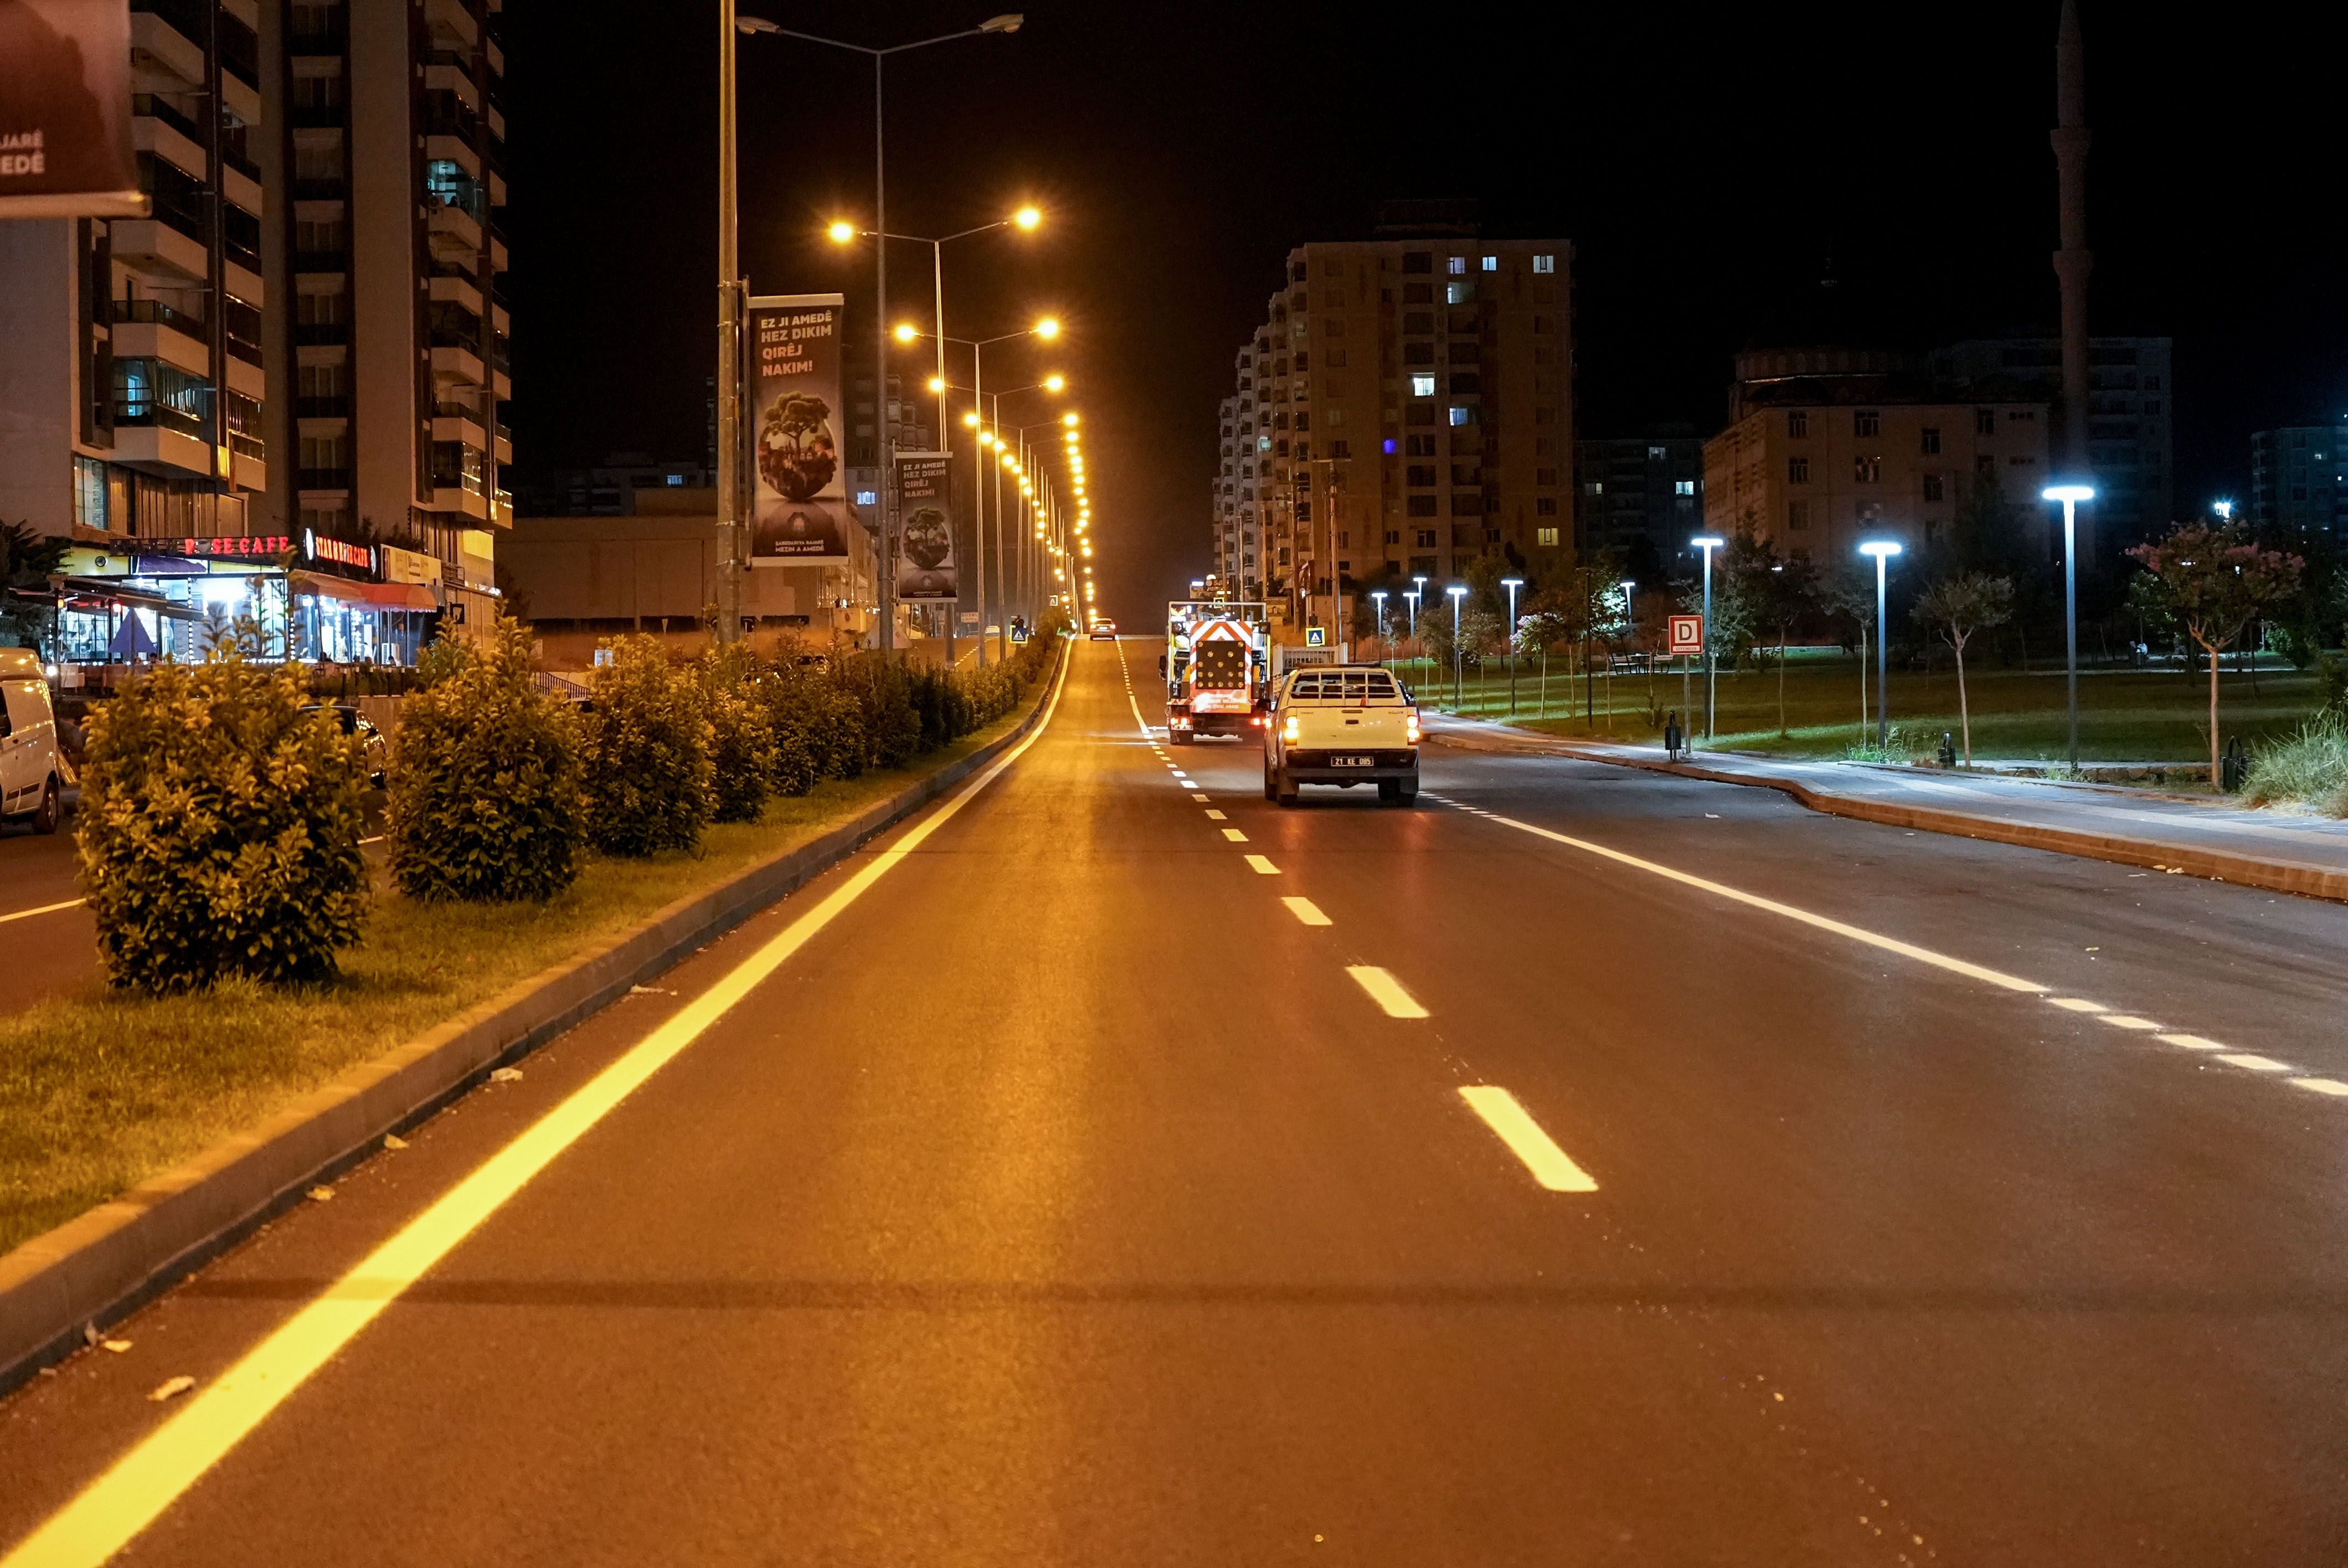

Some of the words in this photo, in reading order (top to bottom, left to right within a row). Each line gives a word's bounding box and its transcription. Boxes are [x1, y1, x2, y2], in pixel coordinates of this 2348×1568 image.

[761, 318, 775, 329] EZ
[779, 317, 789, 327] JI
[792, 310, 832, 326] AMEDÊ
[761, 329, 788, 343] HEZ
[792, 324, 832, 339] DIKIM
[763, 343, 802, 360] QIRÊJ
[763, 360, 812, 376] NAKIM!
[239, 536, 289, 554] CAFE
[1678, 623, 1692, 641] D
